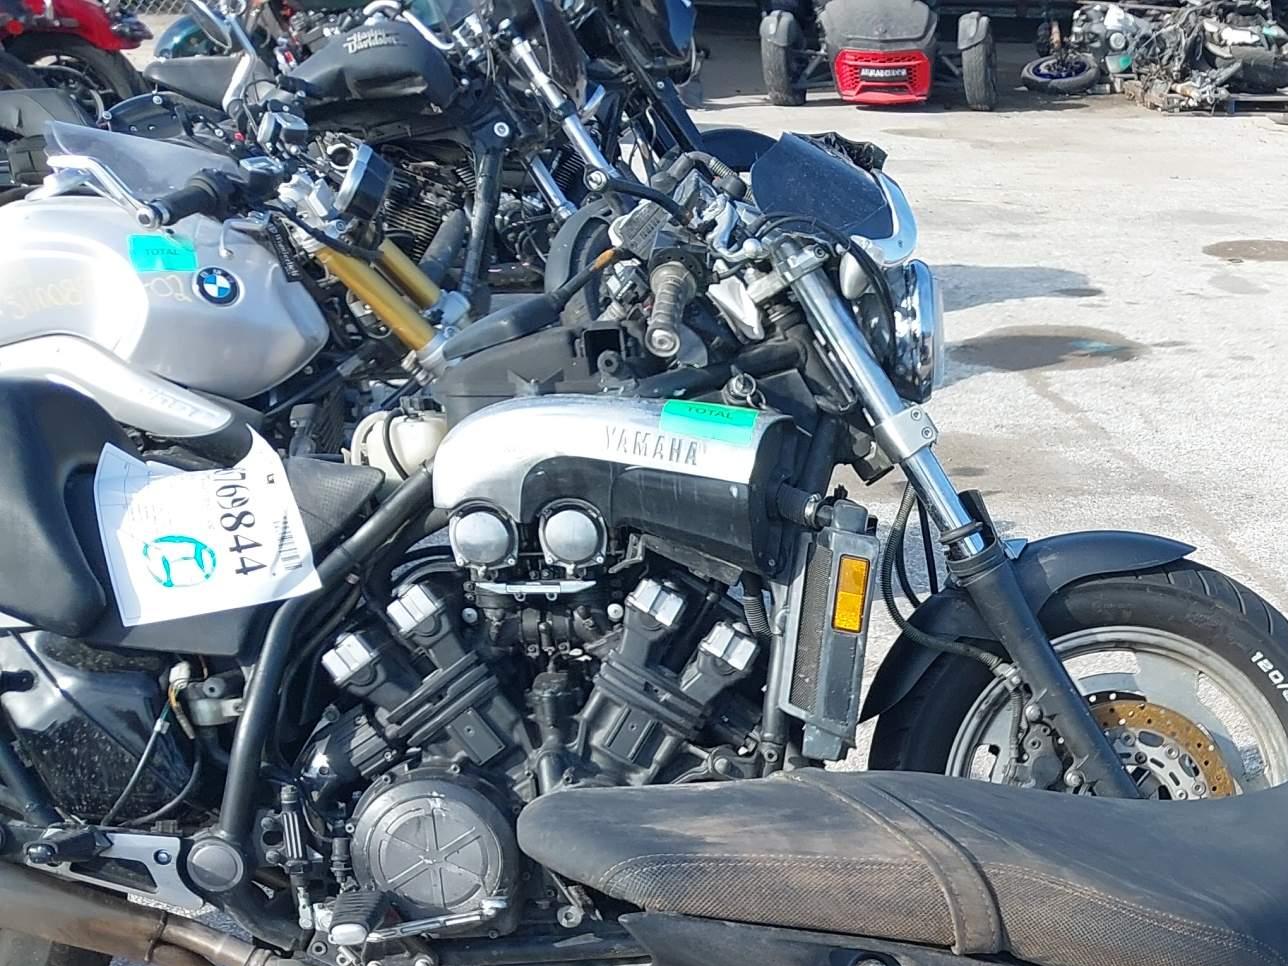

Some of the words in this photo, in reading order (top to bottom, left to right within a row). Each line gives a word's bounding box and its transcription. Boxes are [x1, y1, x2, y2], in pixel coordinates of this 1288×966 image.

[145, 247, 180, 256] TOTAL
[687, 406, 735, 420] TOTAL
[604, 425, 700, 466] YAMAHA
